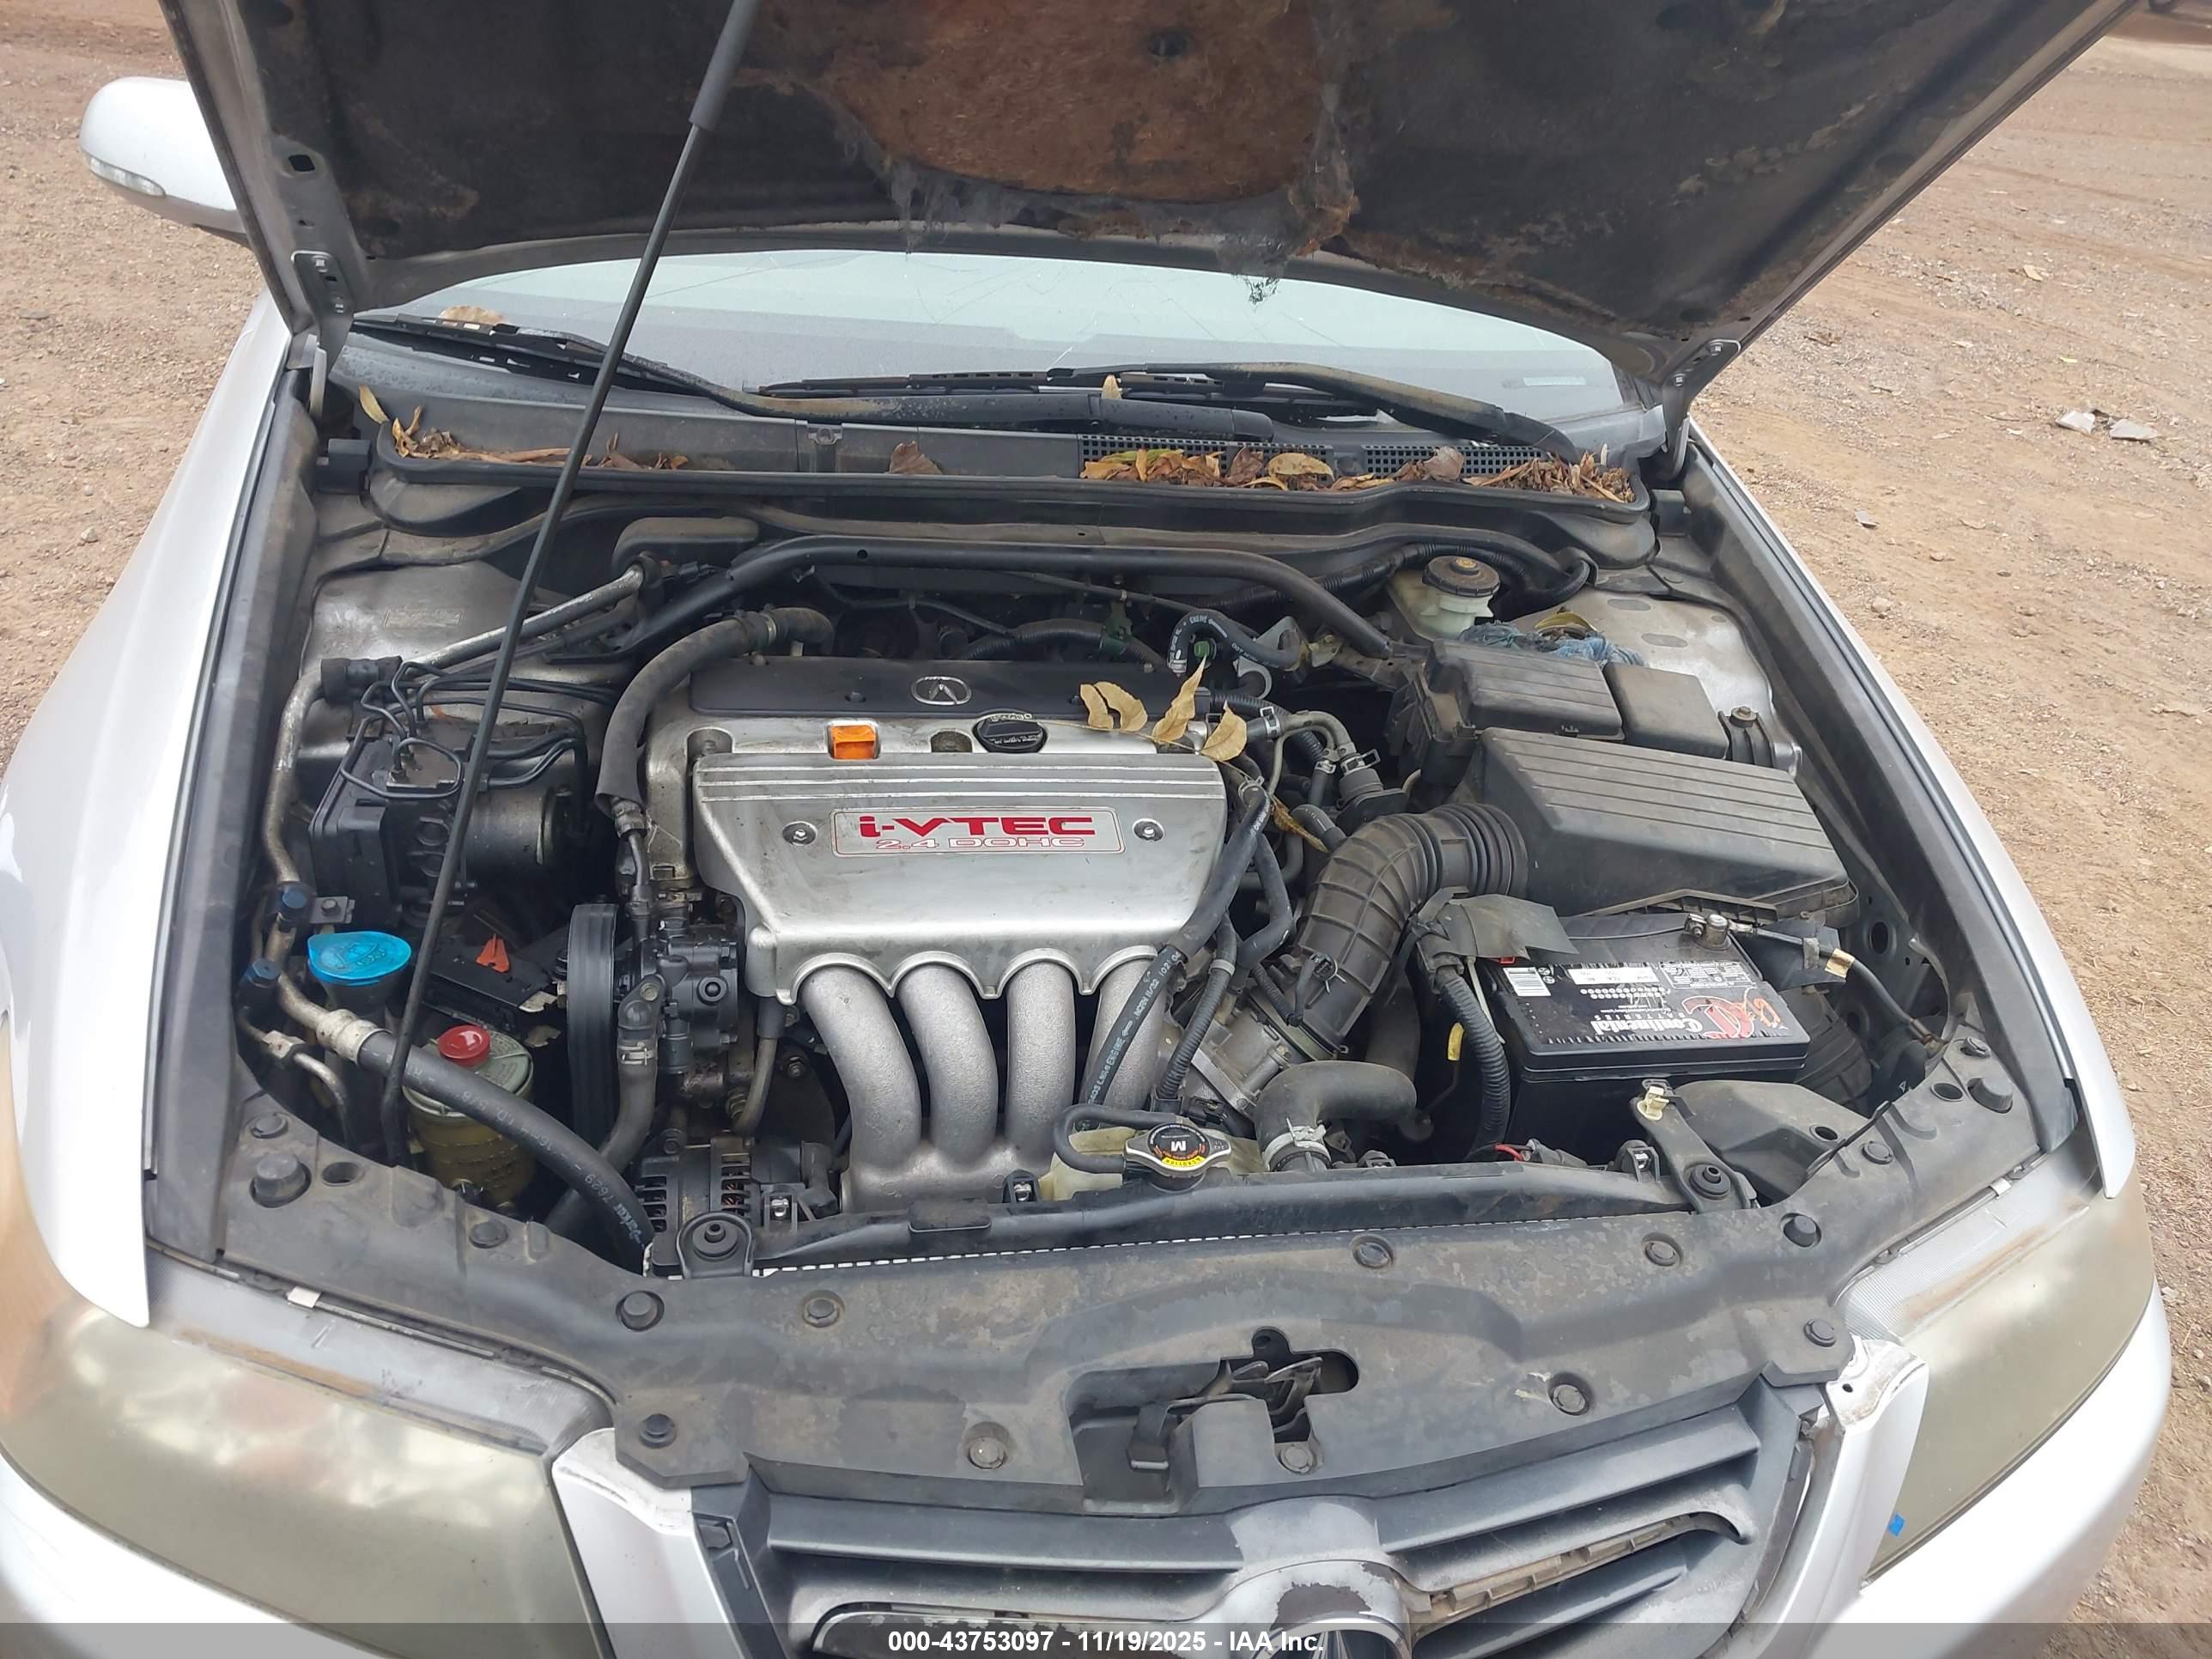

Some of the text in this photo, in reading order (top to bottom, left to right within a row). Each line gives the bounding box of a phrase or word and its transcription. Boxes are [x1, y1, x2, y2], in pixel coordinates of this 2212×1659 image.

[860, 816, 1096, 837] i-VTEC
[876, 837, 1085, 849] 2.4 DOHC
[1591, 1018, 1703, 1036] Continental
